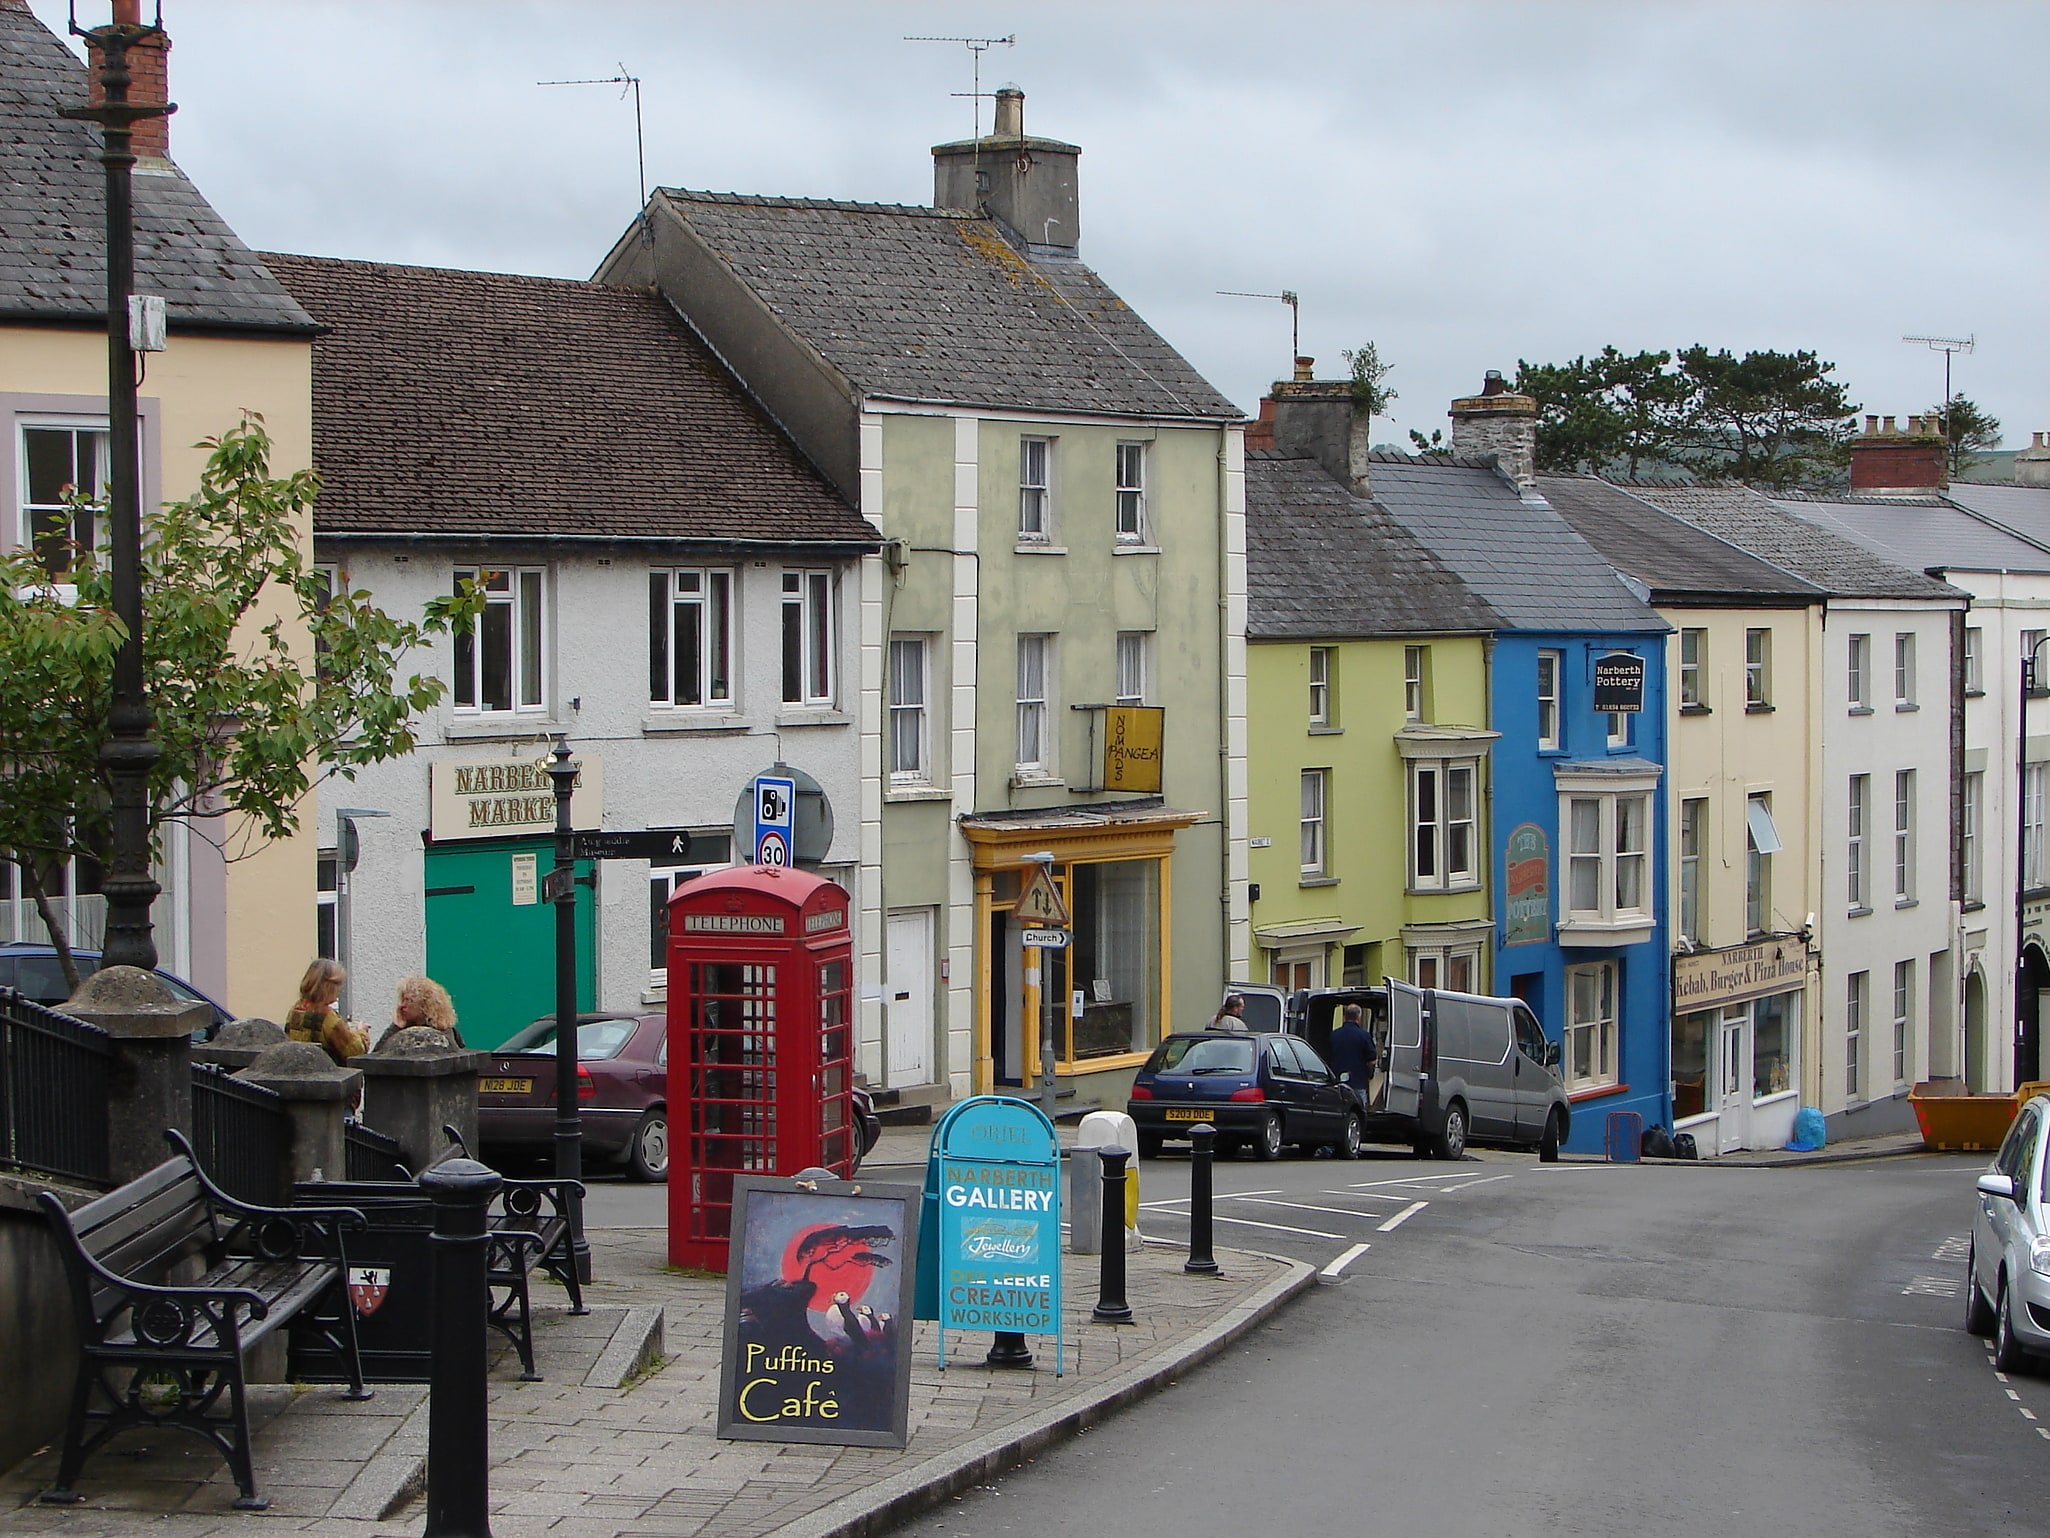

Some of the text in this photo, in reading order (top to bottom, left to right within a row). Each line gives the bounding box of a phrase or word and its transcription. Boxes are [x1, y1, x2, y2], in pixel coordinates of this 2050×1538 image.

[1597, 665, 1641, 675] Narberth
[1596, 676, 1641, 688] Pottery
[1107, 745, 1159, 760] PANGEA
[455, 761, 583, 795] NARBER
[469, 796, 557, 827] MARKE
[763, 845, 783, 866] 30
[692, 915, 781, 931] TELEPHONE
[806, 910, 842, 932] TELEPHONE
[1025, 928, 1058, 942] Church
[1711, 970, 1744, 994] Burger
[1778, 956, 1804, 976] House
[507, 1080, 526, 1091] JDE
[1169, 1109, 1191, 1119] S203
[947, 1166, 1052, 1187] NARBERTH
[946, 1185, 1054, 1212] GALLERY
[968, 1236, 1031, 1259] Jewellery
[993, 1272, 1051, 1288] LEEKE
[949, 1286, 1050, 1310] CREATIVE
[950, 1308, 1051, 1328] WORKSHOP
[746, 1342, 835, 1375] Puffins
